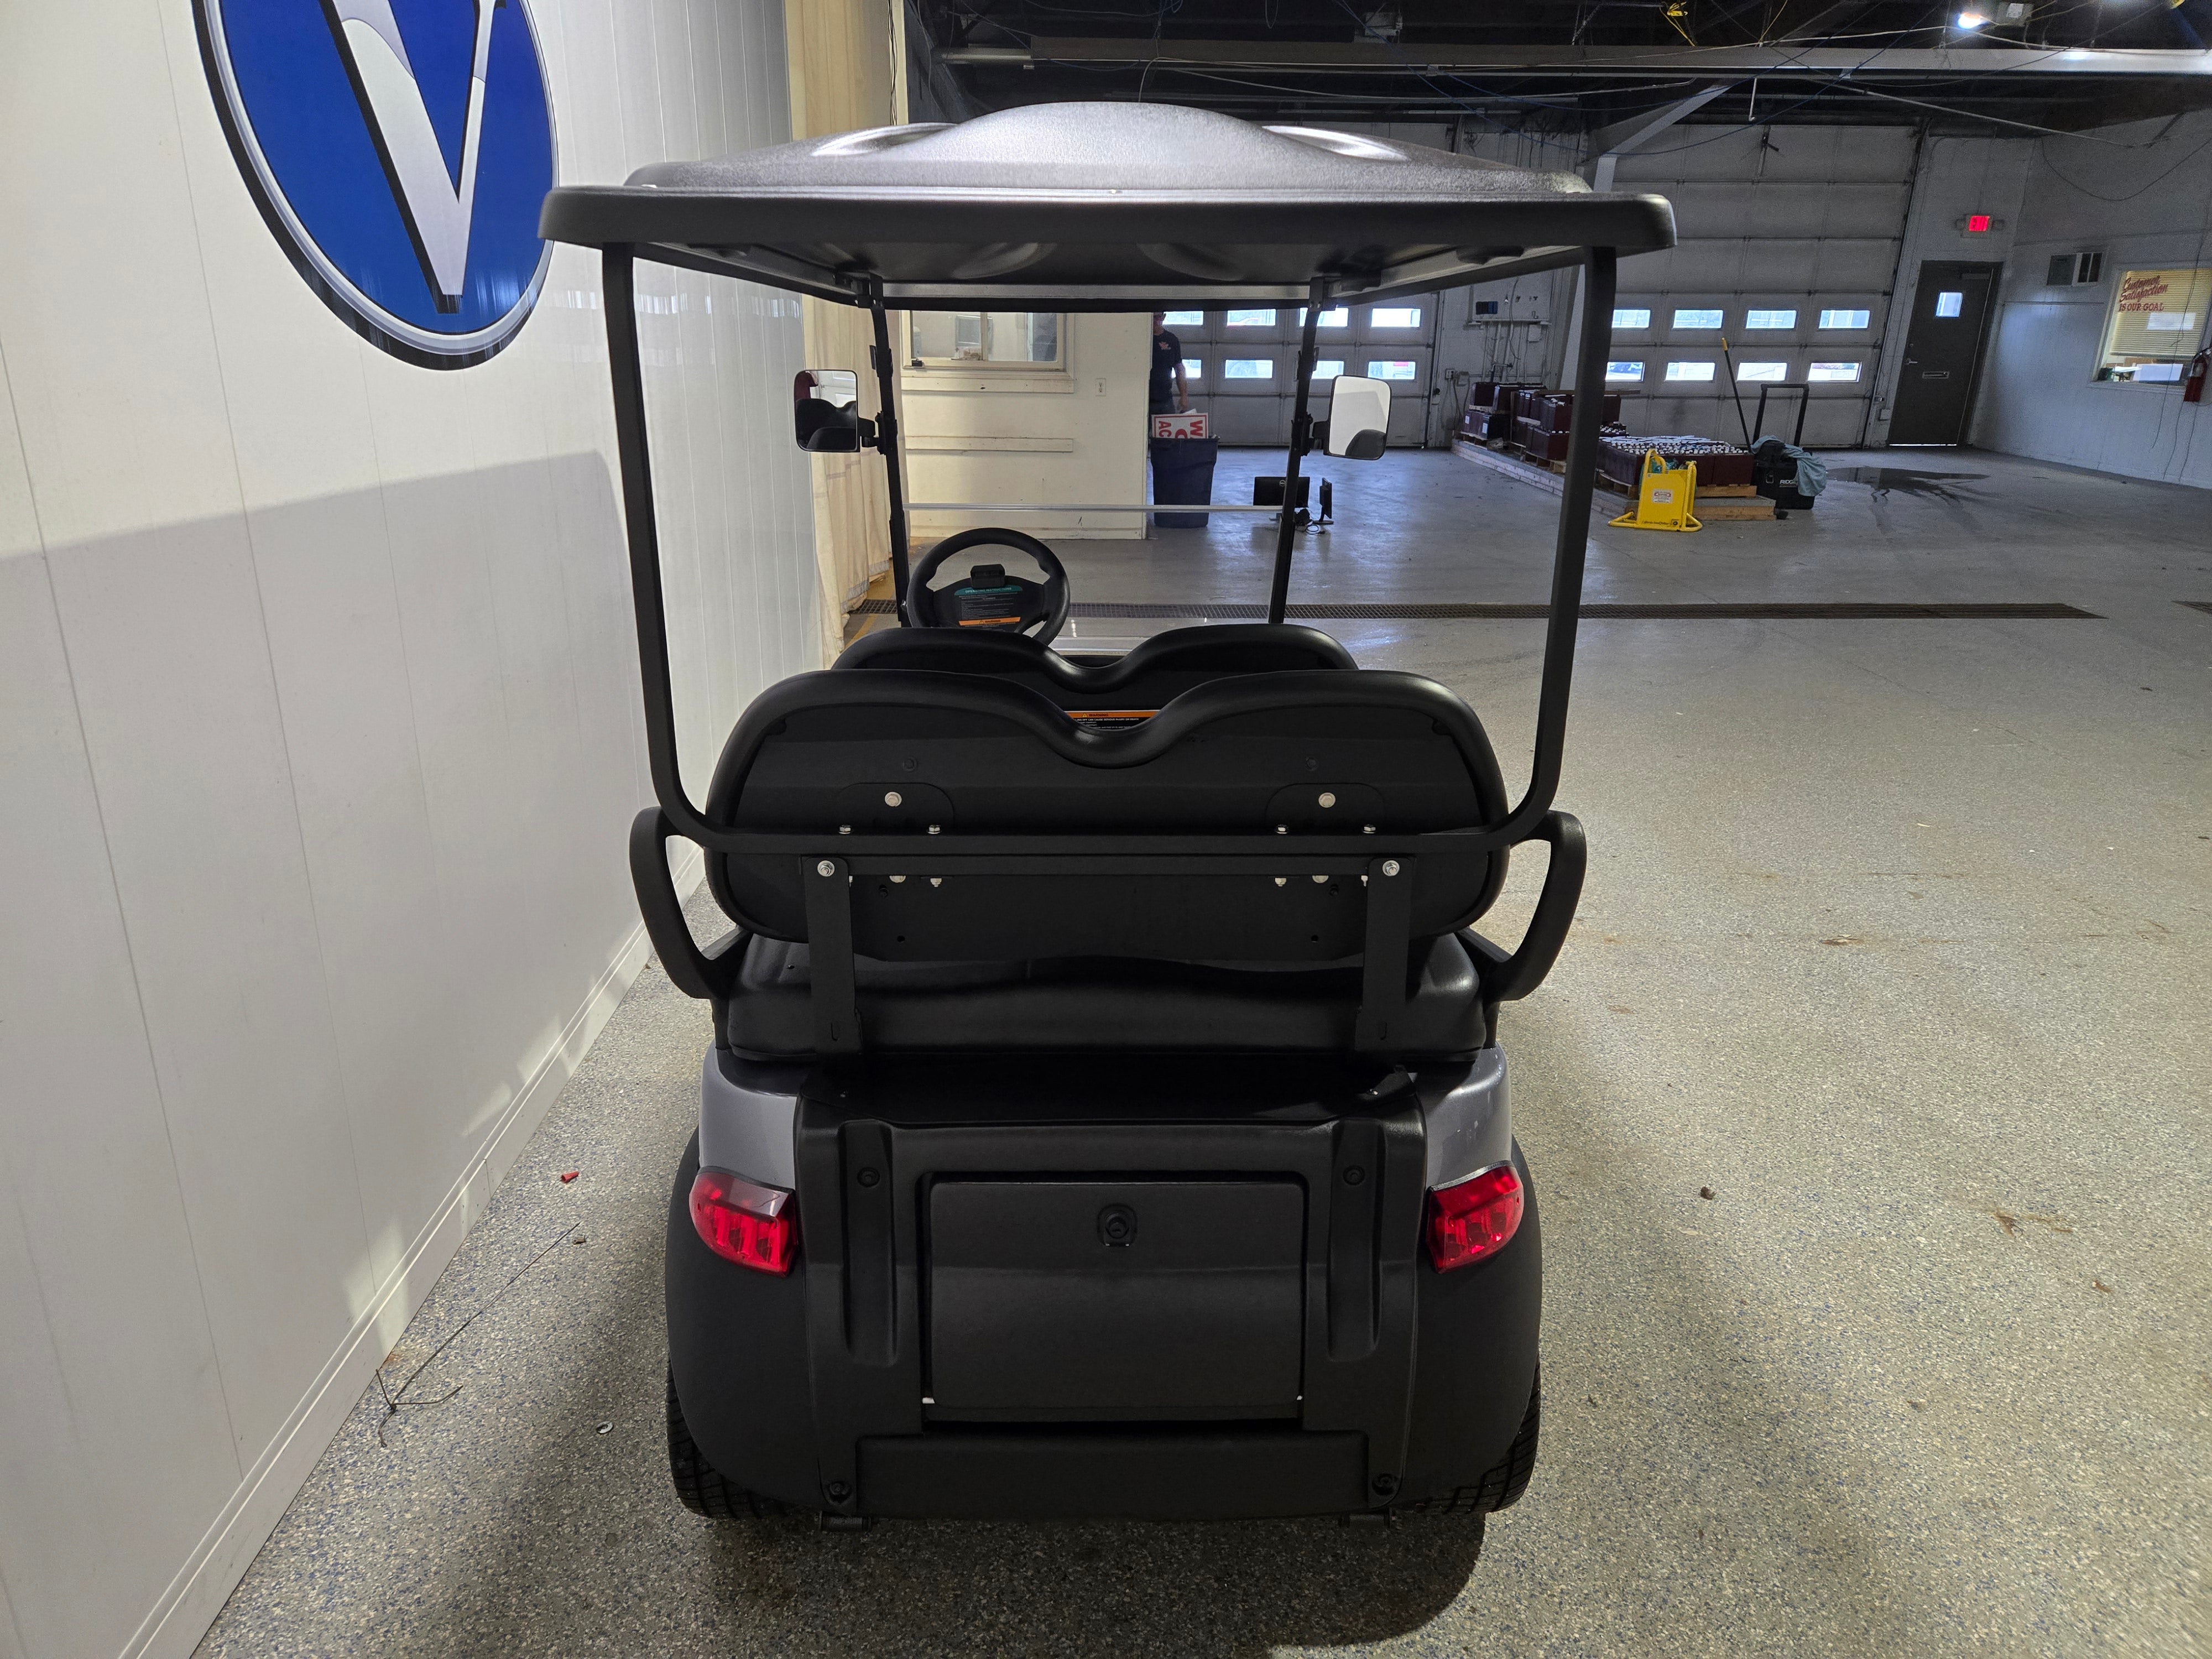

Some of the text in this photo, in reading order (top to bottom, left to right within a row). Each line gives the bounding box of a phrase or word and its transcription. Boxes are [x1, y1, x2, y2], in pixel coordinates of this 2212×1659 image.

[2122, 275, 2161, 291] Customer
[2119, 284, 2169, 302] Satisfaction
[2119, 302, 2164, 311] IS OUR GOAL
[1190, 420, 1203, 439] W
